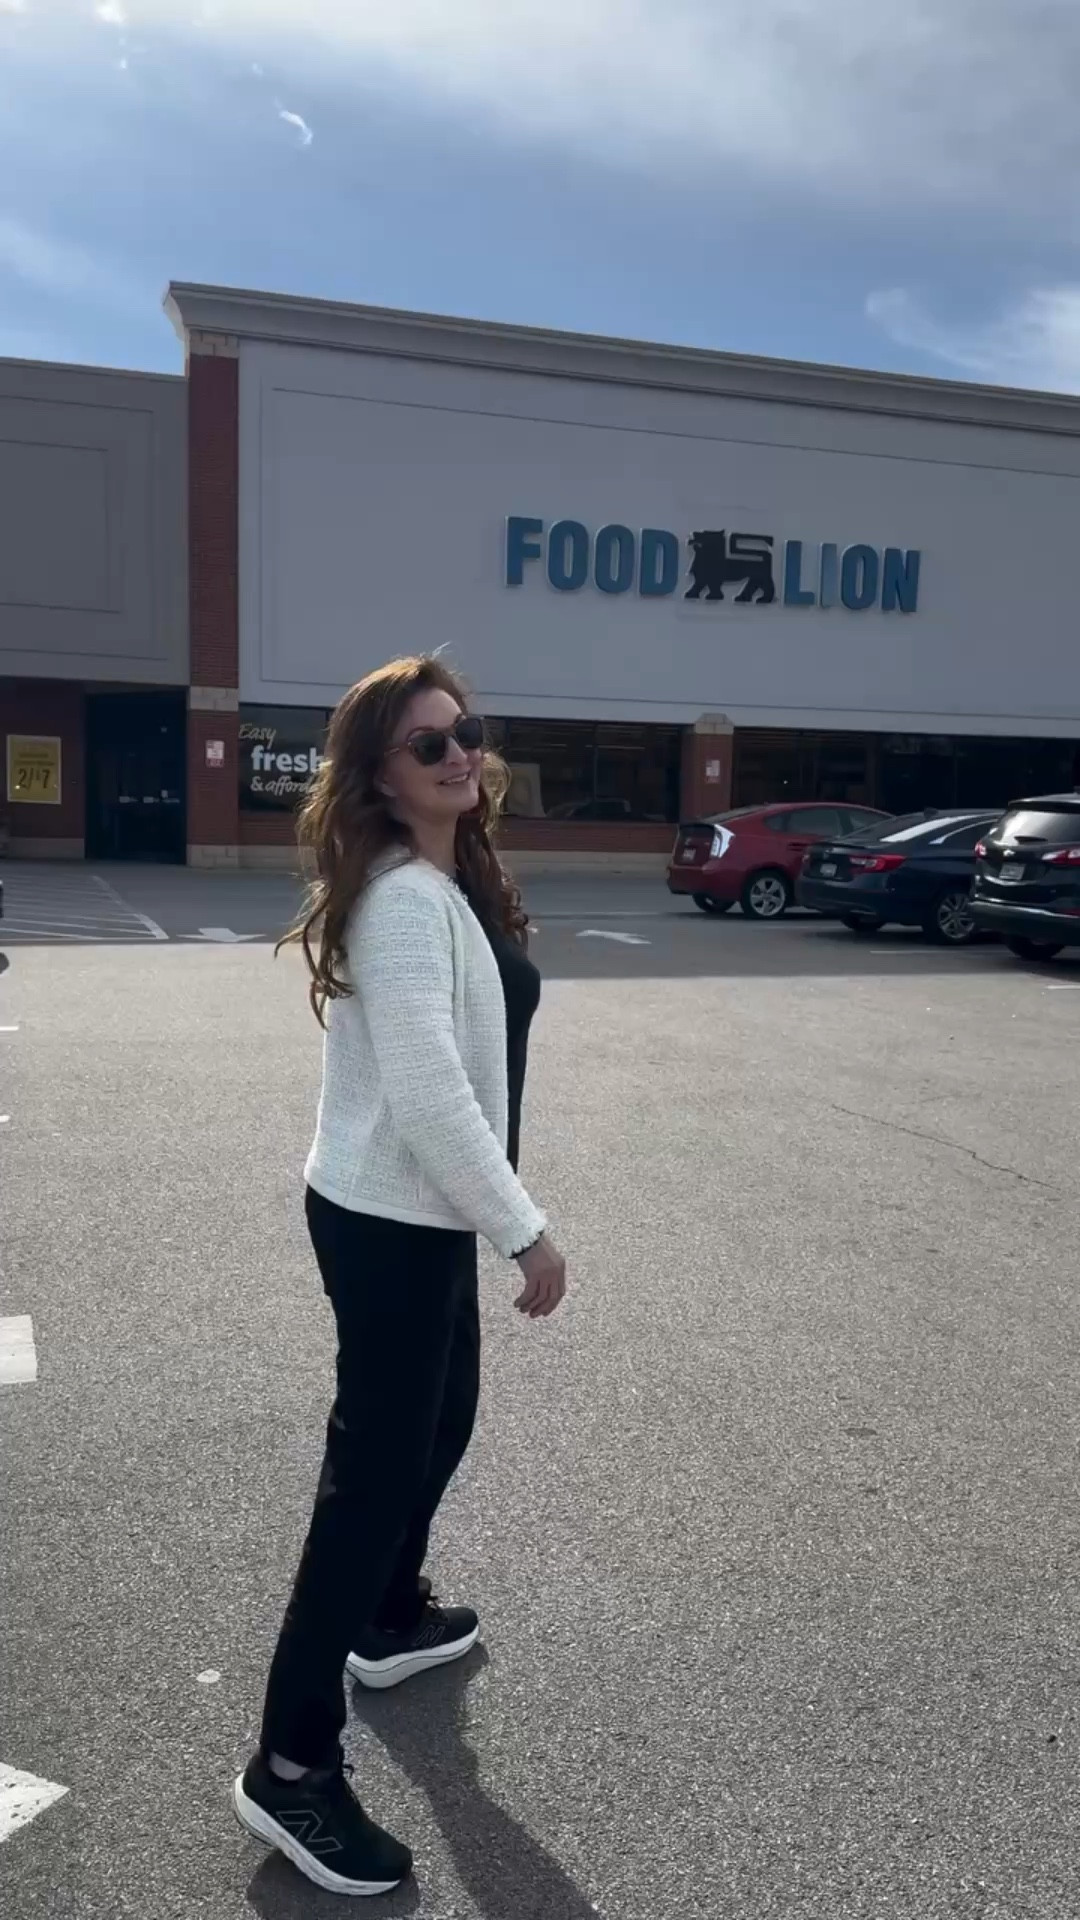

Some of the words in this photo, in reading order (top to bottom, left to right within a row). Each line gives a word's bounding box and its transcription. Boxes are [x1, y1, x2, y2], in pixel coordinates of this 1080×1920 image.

[505, 515, 680, 597] FOOD
[783, 539, 921, 613] LION
[238, 722, 277, 750] Easy
[250, 775, 264, 792] &
